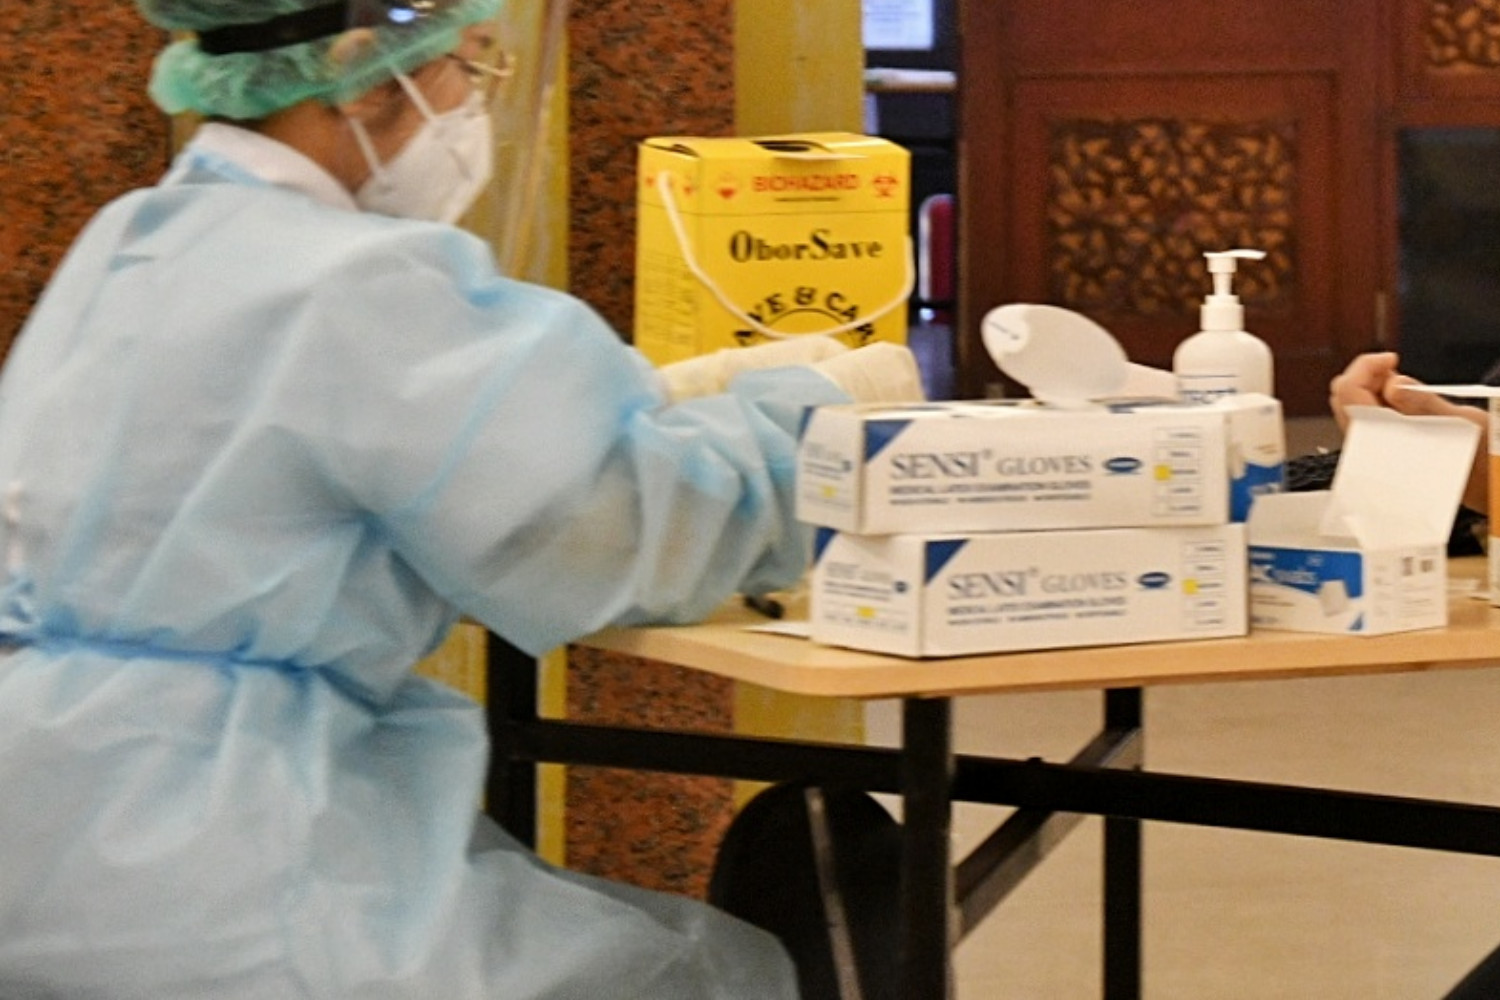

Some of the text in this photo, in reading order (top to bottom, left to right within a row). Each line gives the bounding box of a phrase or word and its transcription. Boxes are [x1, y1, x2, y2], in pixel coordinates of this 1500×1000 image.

[753, 174, 858, 192] BIOHAZARD
[729, 228, 883, 263] OborSave
[995, 454, 1093, 476] GLOVES
[1040, 571, 1128, 594] GLOVES
